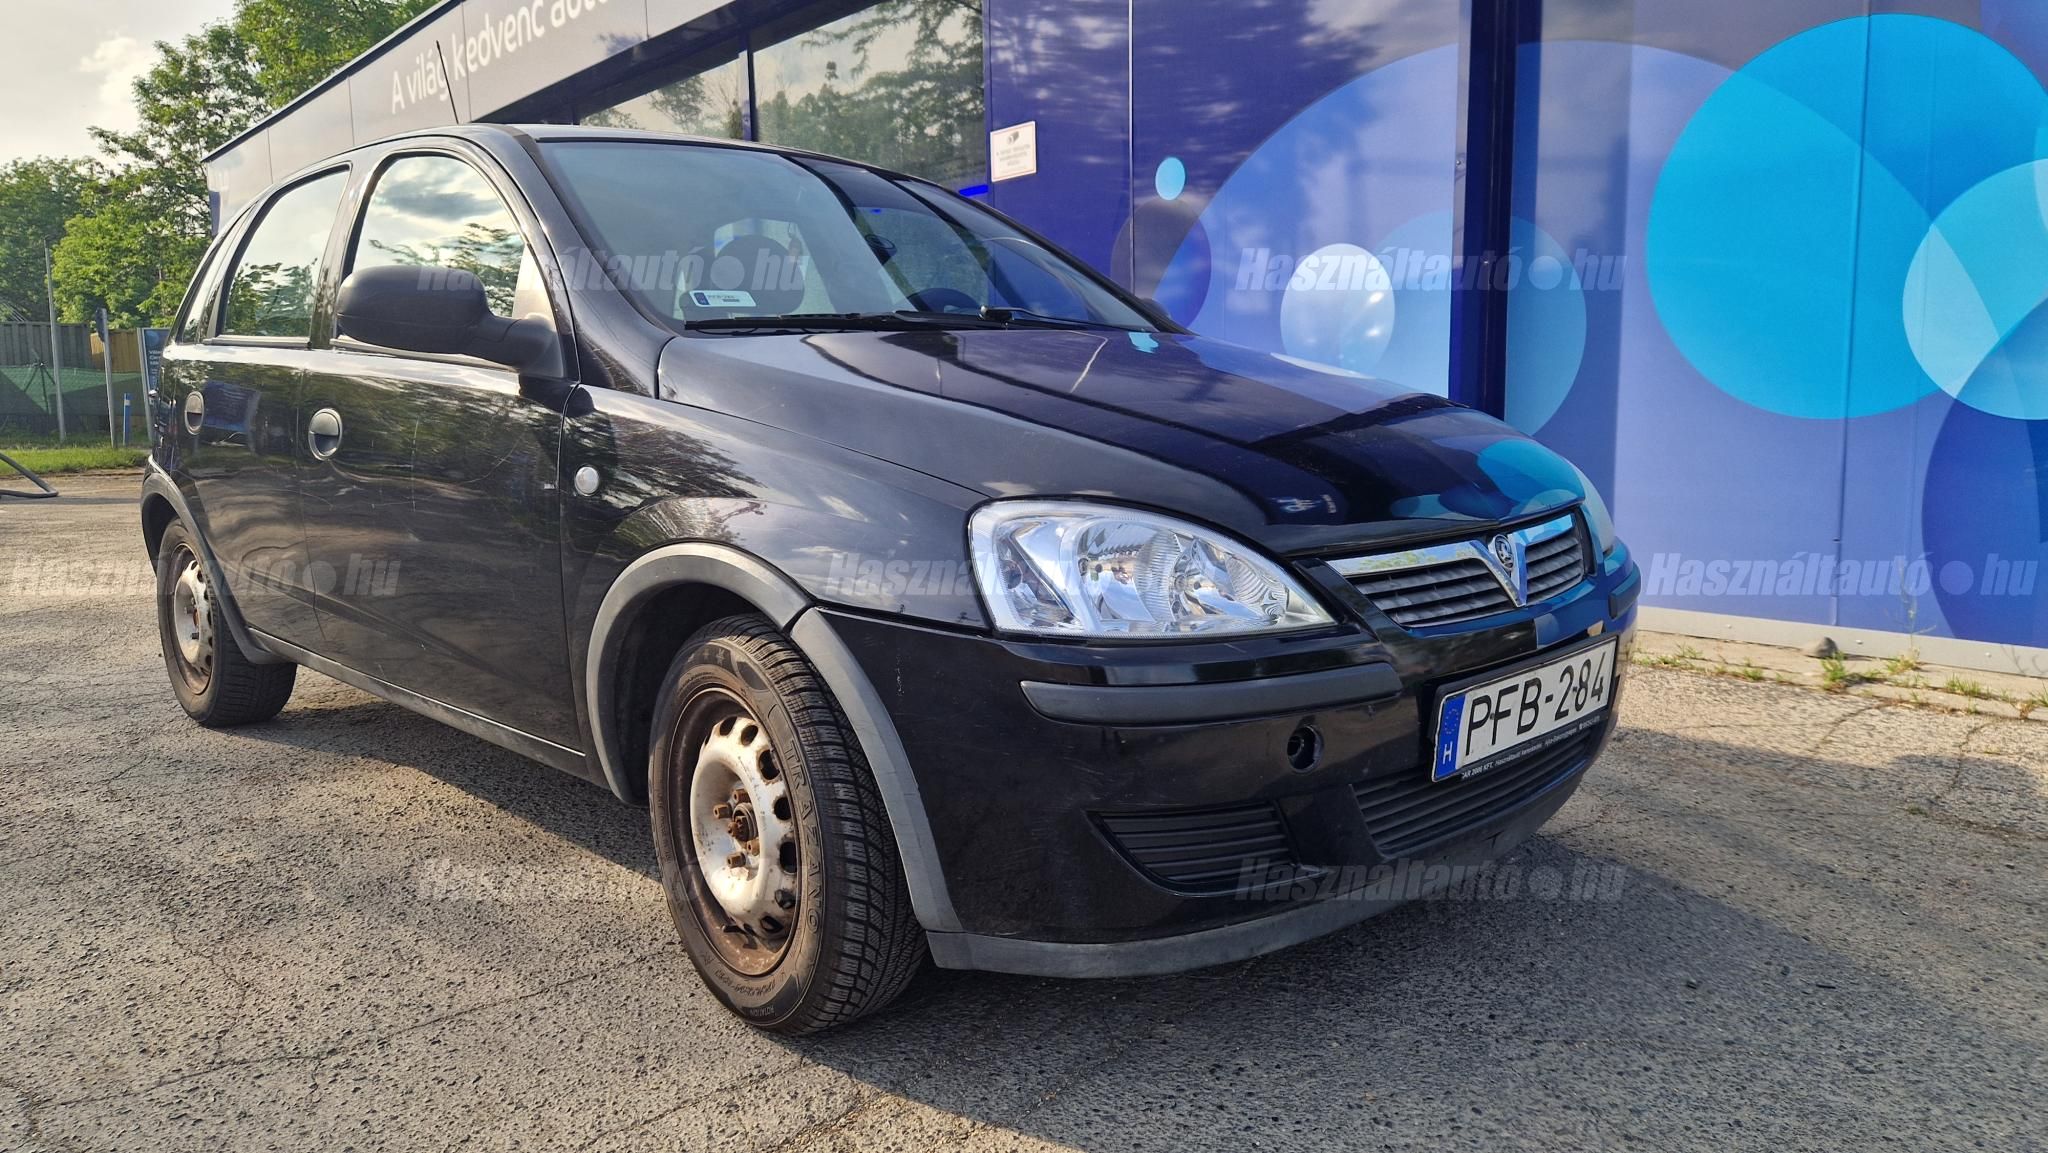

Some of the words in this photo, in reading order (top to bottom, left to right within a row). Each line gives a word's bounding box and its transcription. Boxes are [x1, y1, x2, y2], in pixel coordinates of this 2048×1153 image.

[392, 70, 405, 115] A
[406, 48, 450, 101] világ
[452, 0, 545, 80] kedvenc
[1442, 741, 1453, 764] H
[1465, 652, 1605, 756] PFB-284
[784, 739, 824, 935] TRAZANO
